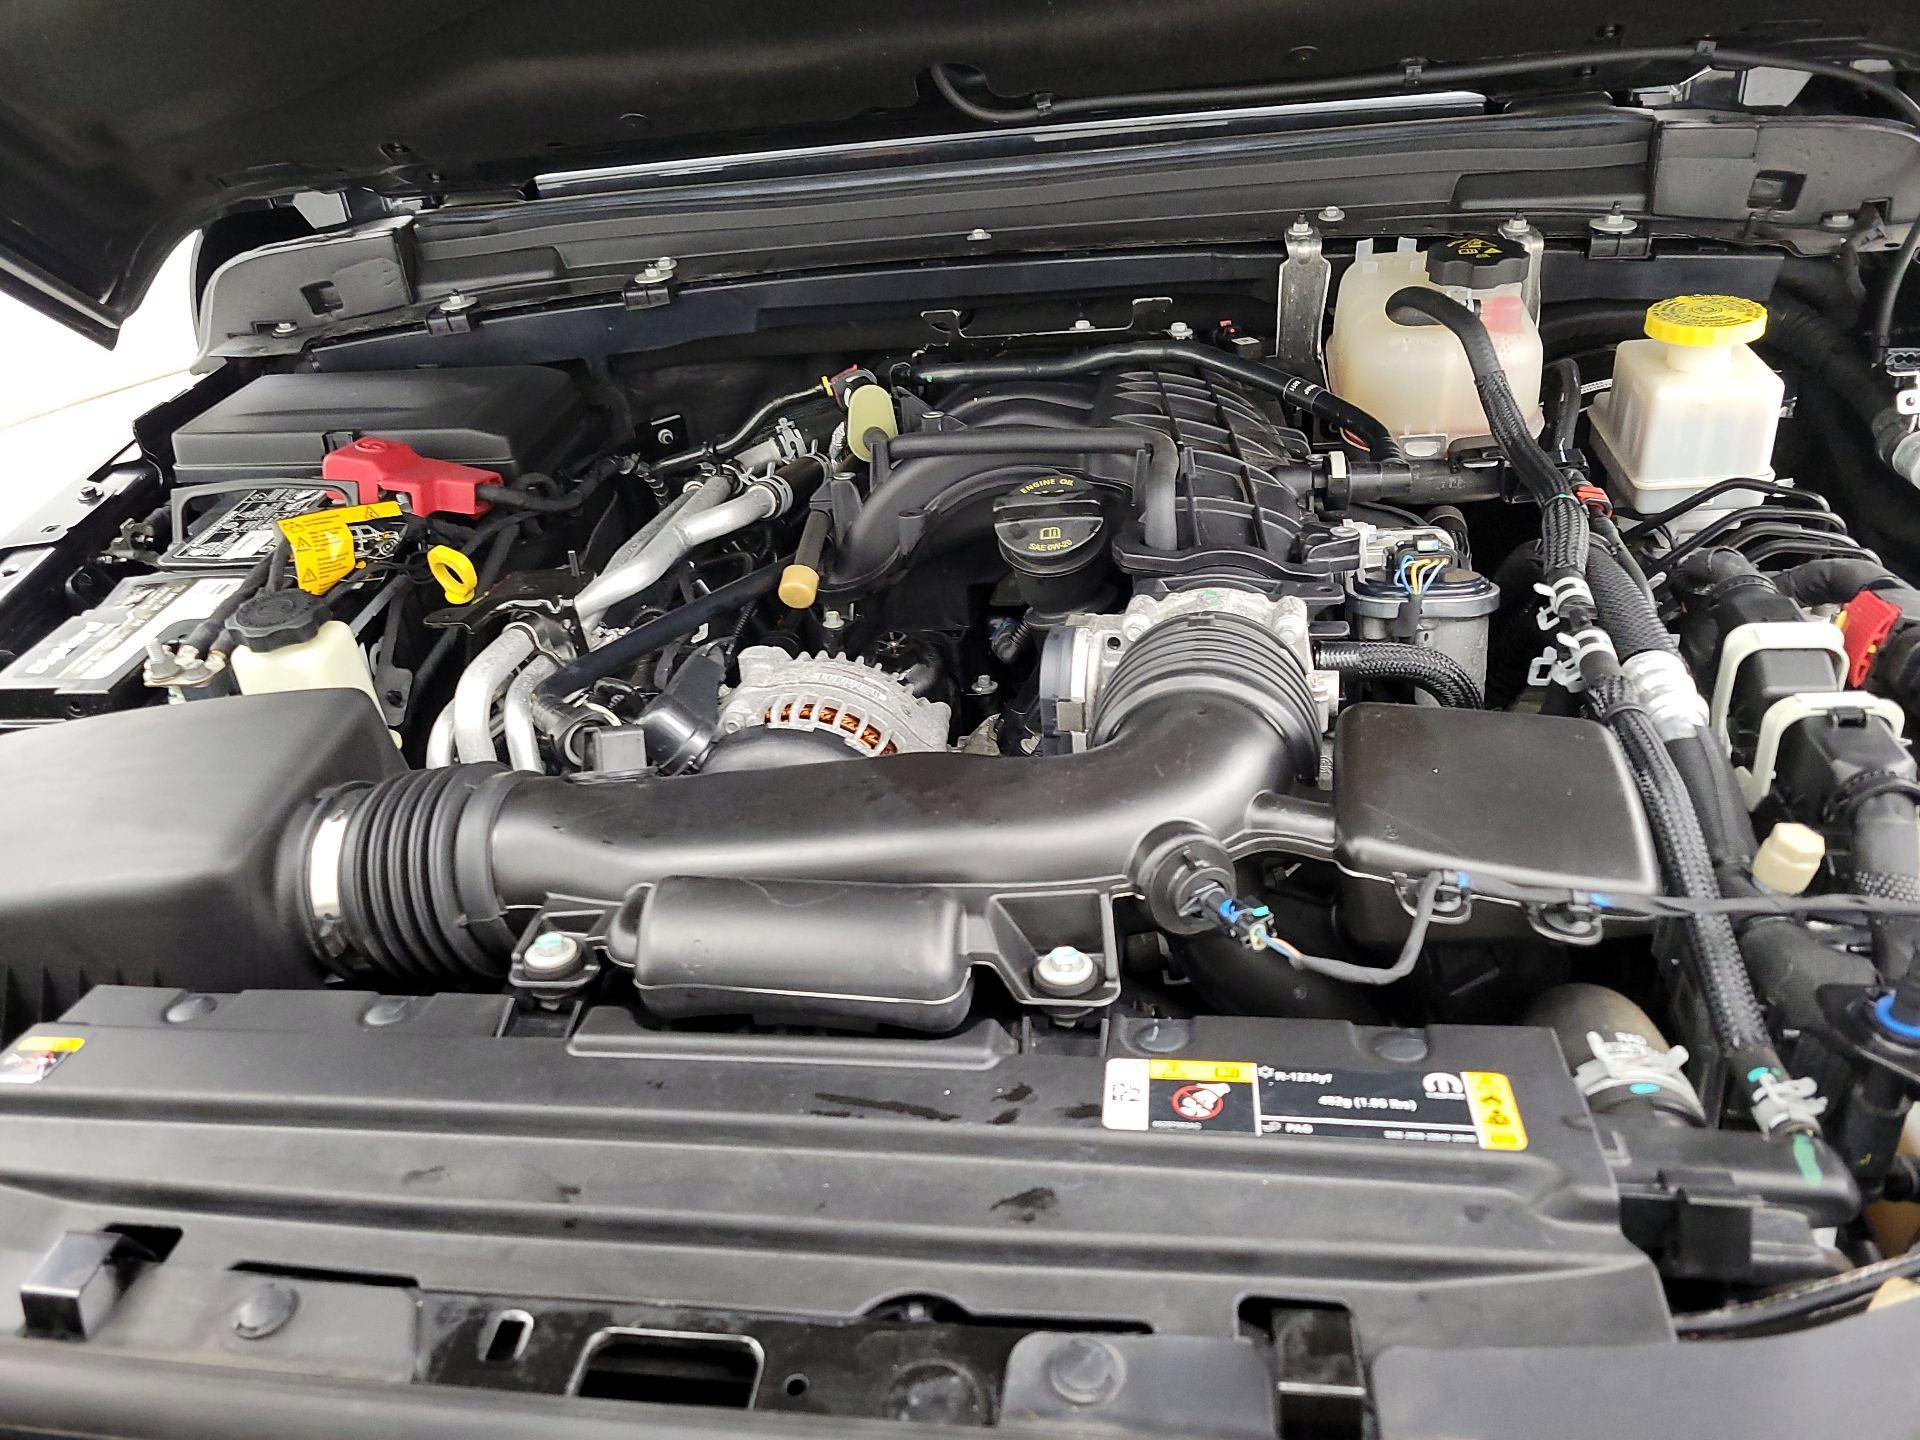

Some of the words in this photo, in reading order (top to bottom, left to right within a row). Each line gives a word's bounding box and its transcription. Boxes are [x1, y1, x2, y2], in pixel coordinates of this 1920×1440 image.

[1020, 478, 1056, 494] ENGINE
[1059, 478, 1074, 487] OIL
[1028, 543, 1046, 551] SAE
[1047, 539, 1073, 550] 0W-20
